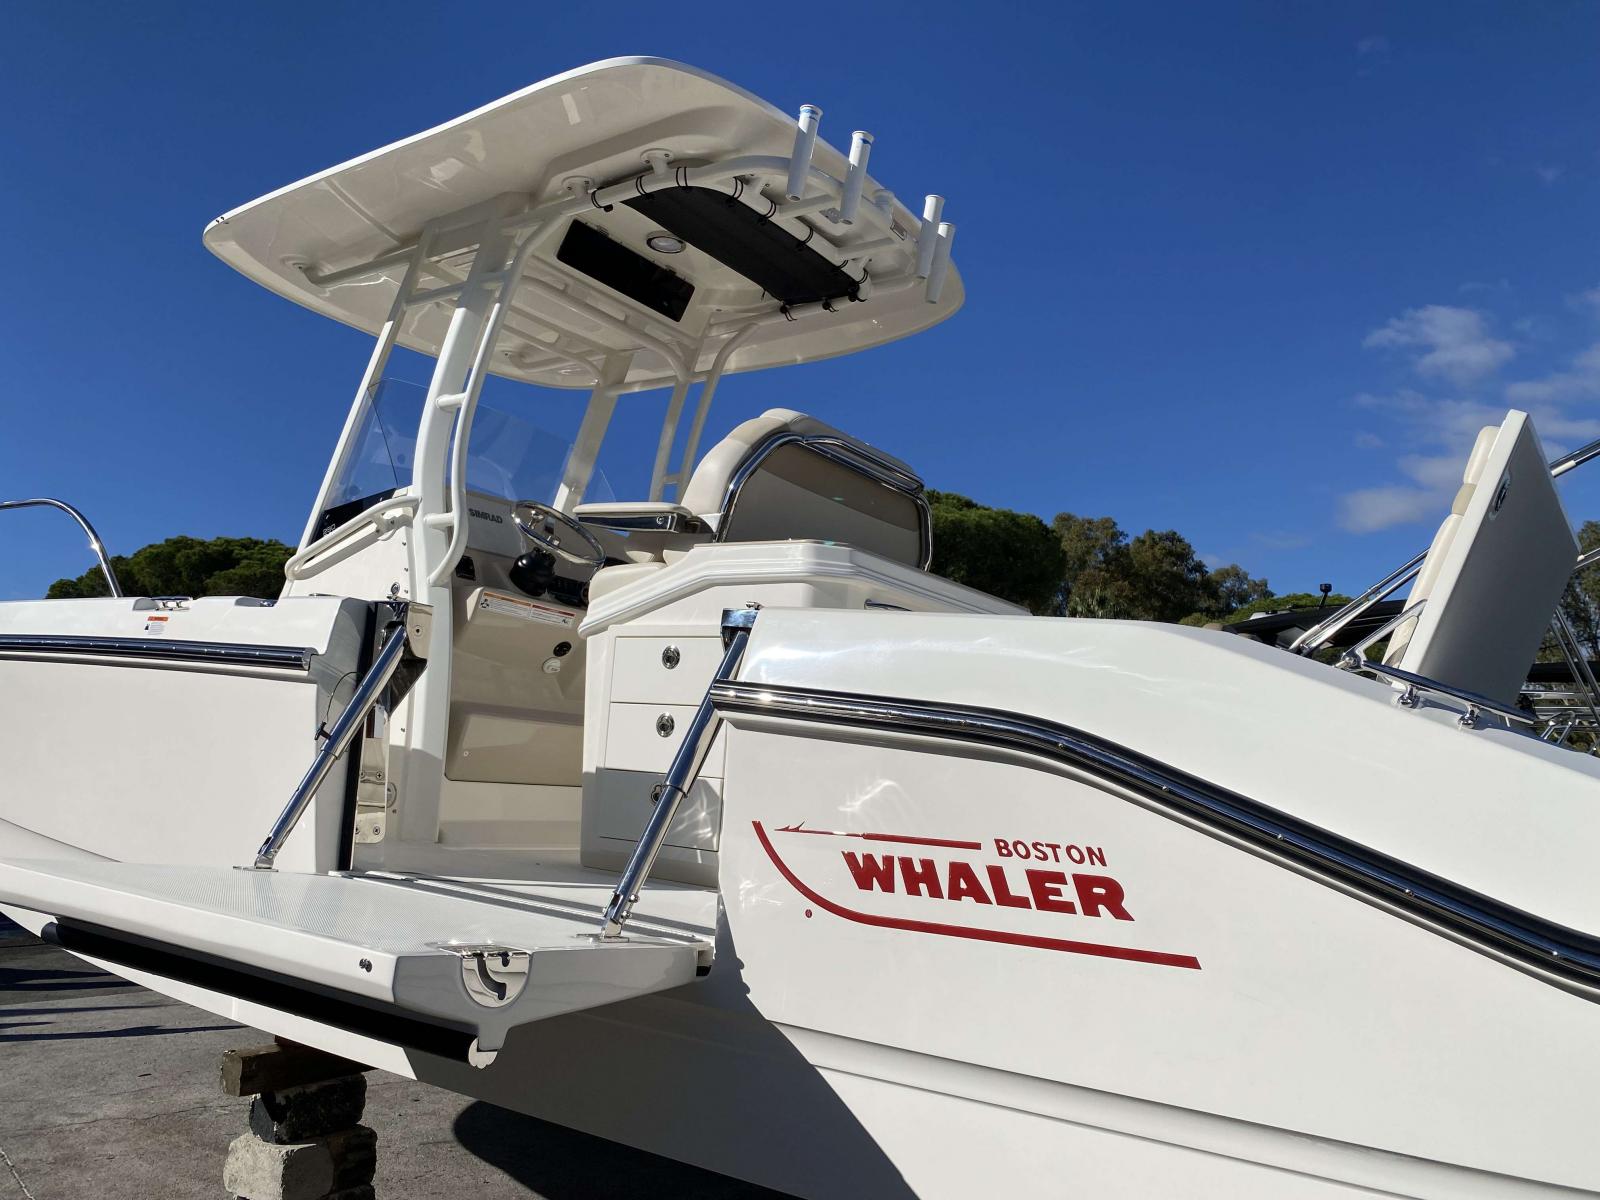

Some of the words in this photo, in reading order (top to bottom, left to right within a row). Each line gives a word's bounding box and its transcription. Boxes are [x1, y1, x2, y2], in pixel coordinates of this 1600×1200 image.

[468, 508, 503, 524] SIMRAD
[994, 838, 1107, 867] BOSTON
[842, 851, 1135, 921] WHALER
